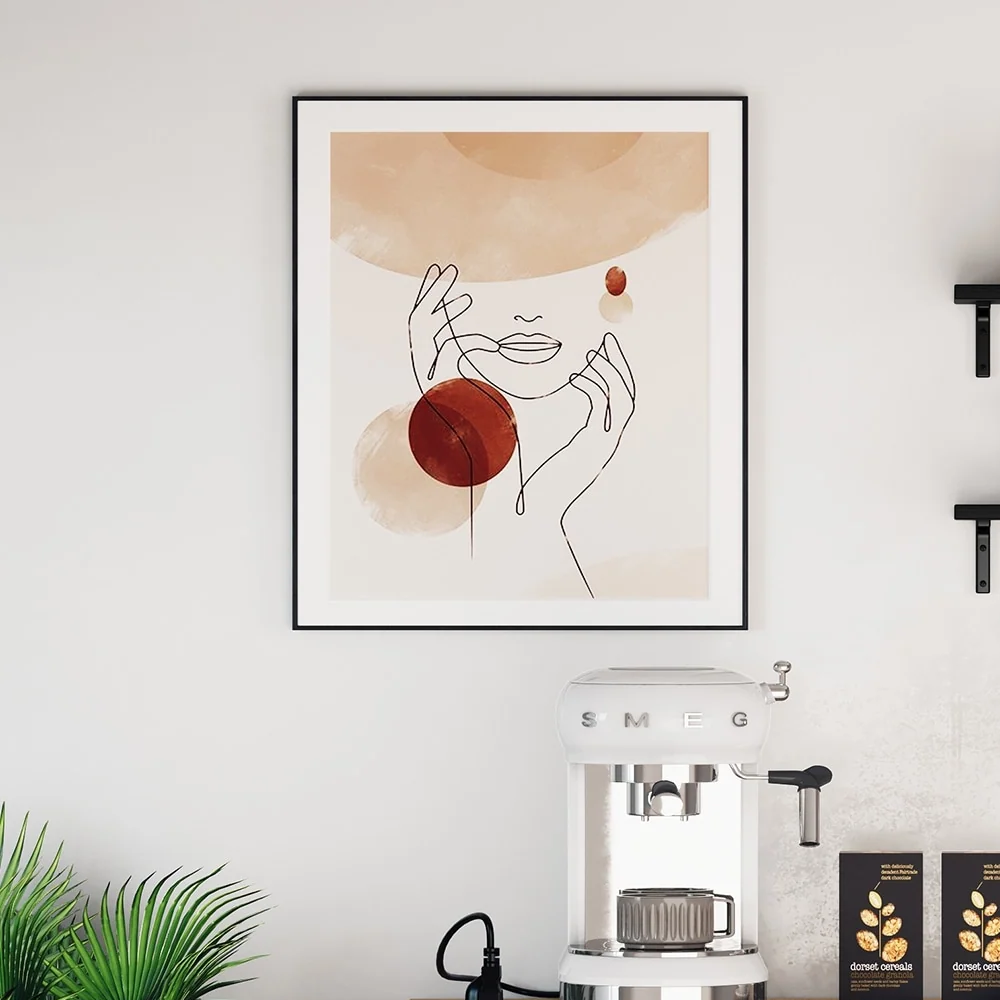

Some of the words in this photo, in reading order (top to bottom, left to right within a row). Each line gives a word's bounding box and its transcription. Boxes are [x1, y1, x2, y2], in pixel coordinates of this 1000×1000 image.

[581, 711, 748, 728] SMEG
[850, 961, 879, 971] dorset
[880, 961, 913, 971] cereals
[952, 961, 982, 971] dorset
[850, 971, 885, 979] chocolate
[886, 971, 914, 980] granola
[952, 971, 987, 979] chocolate
